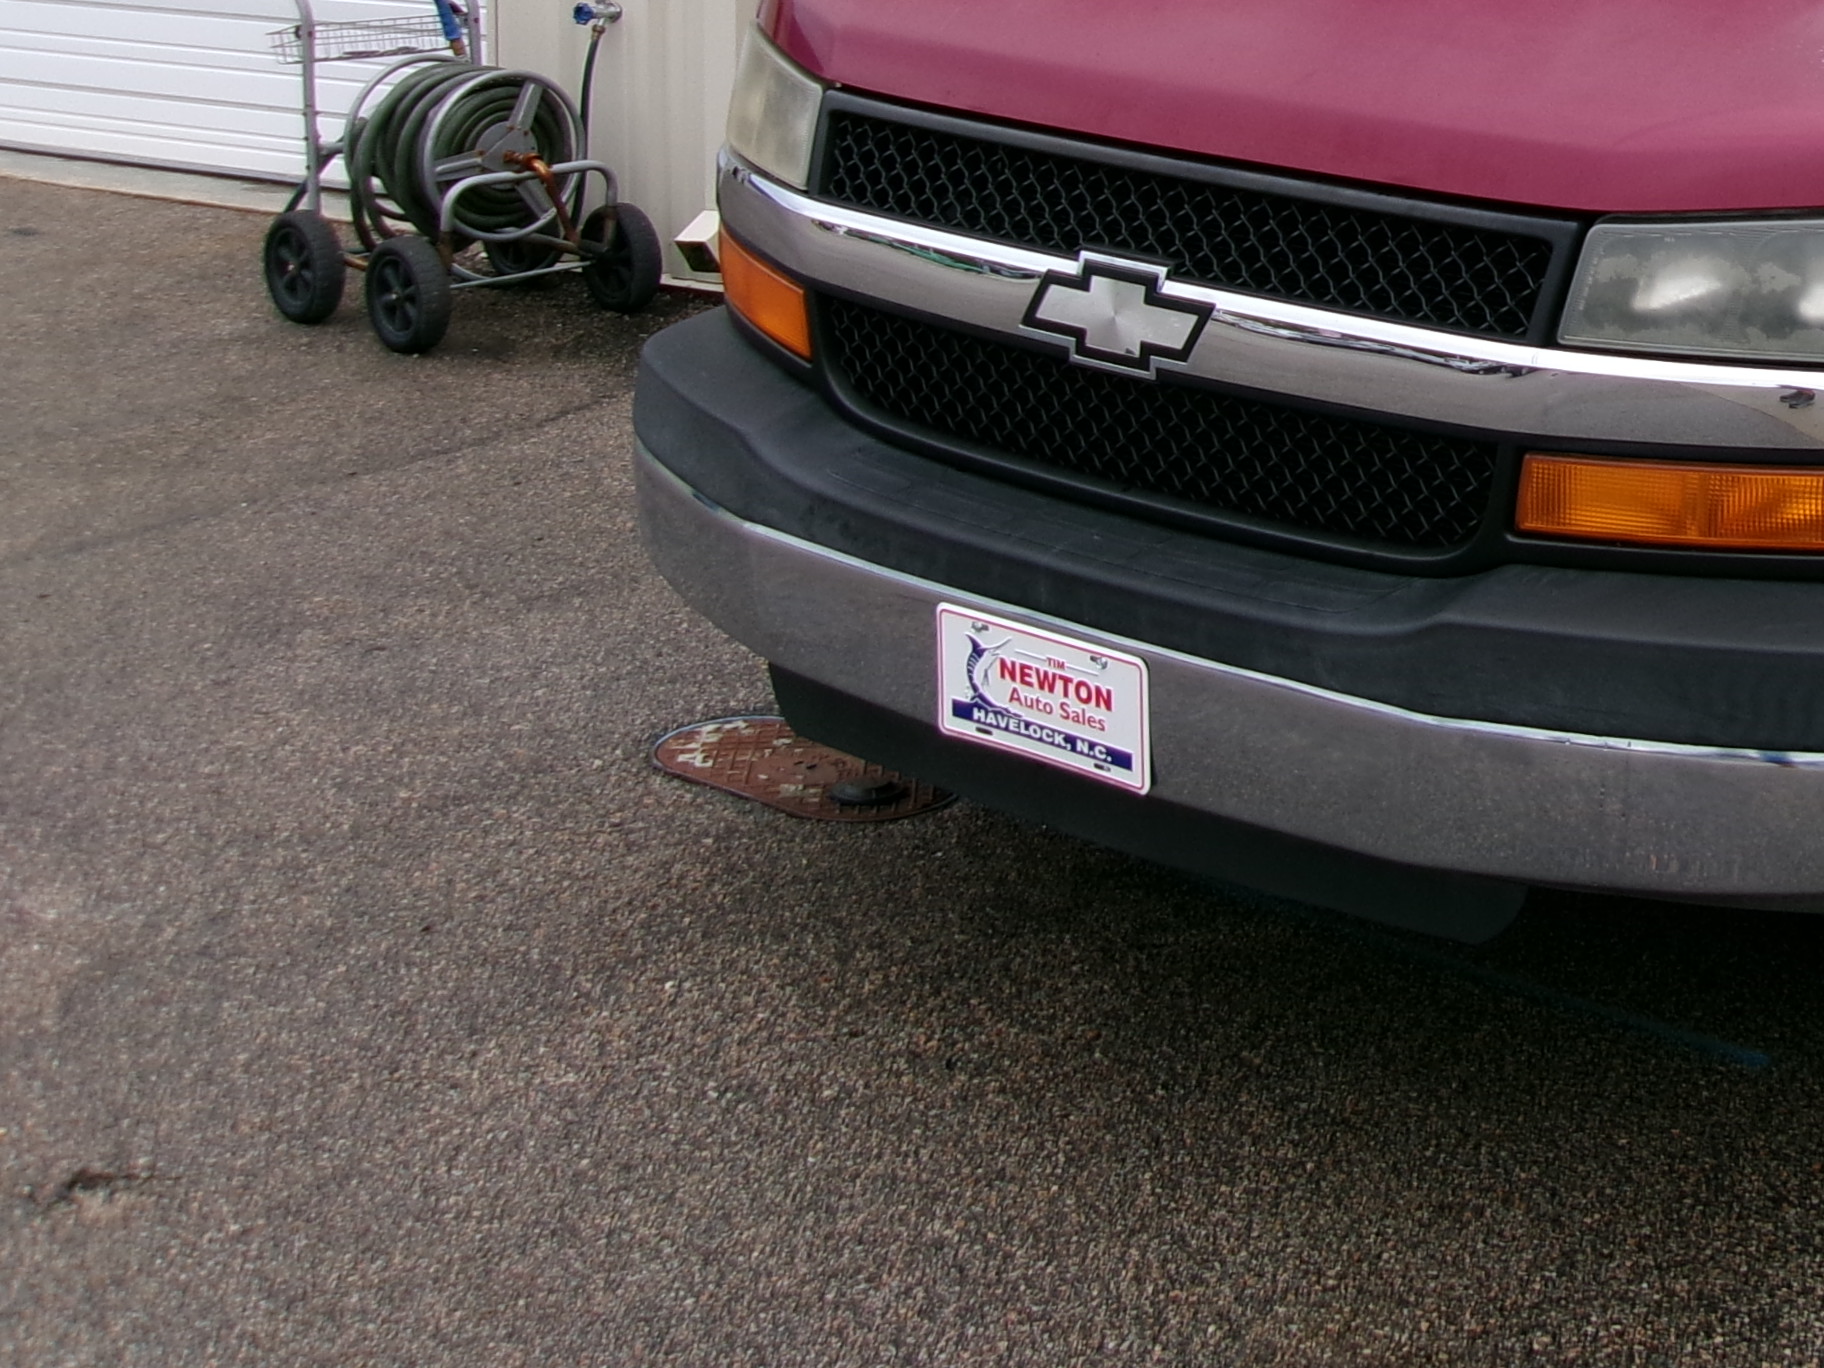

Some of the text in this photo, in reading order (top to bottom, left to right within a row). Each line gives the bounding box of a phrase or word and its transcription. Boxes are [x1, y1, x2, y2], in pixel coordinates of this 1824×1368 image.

[998, 657, 1113, 712] NEWTON
[1046, 656, 1066, 671] TIM
[972, 706, 1113, 762] HAVELOCK, N.C.
[1008, 687, 1106, 732] Auto Sales
